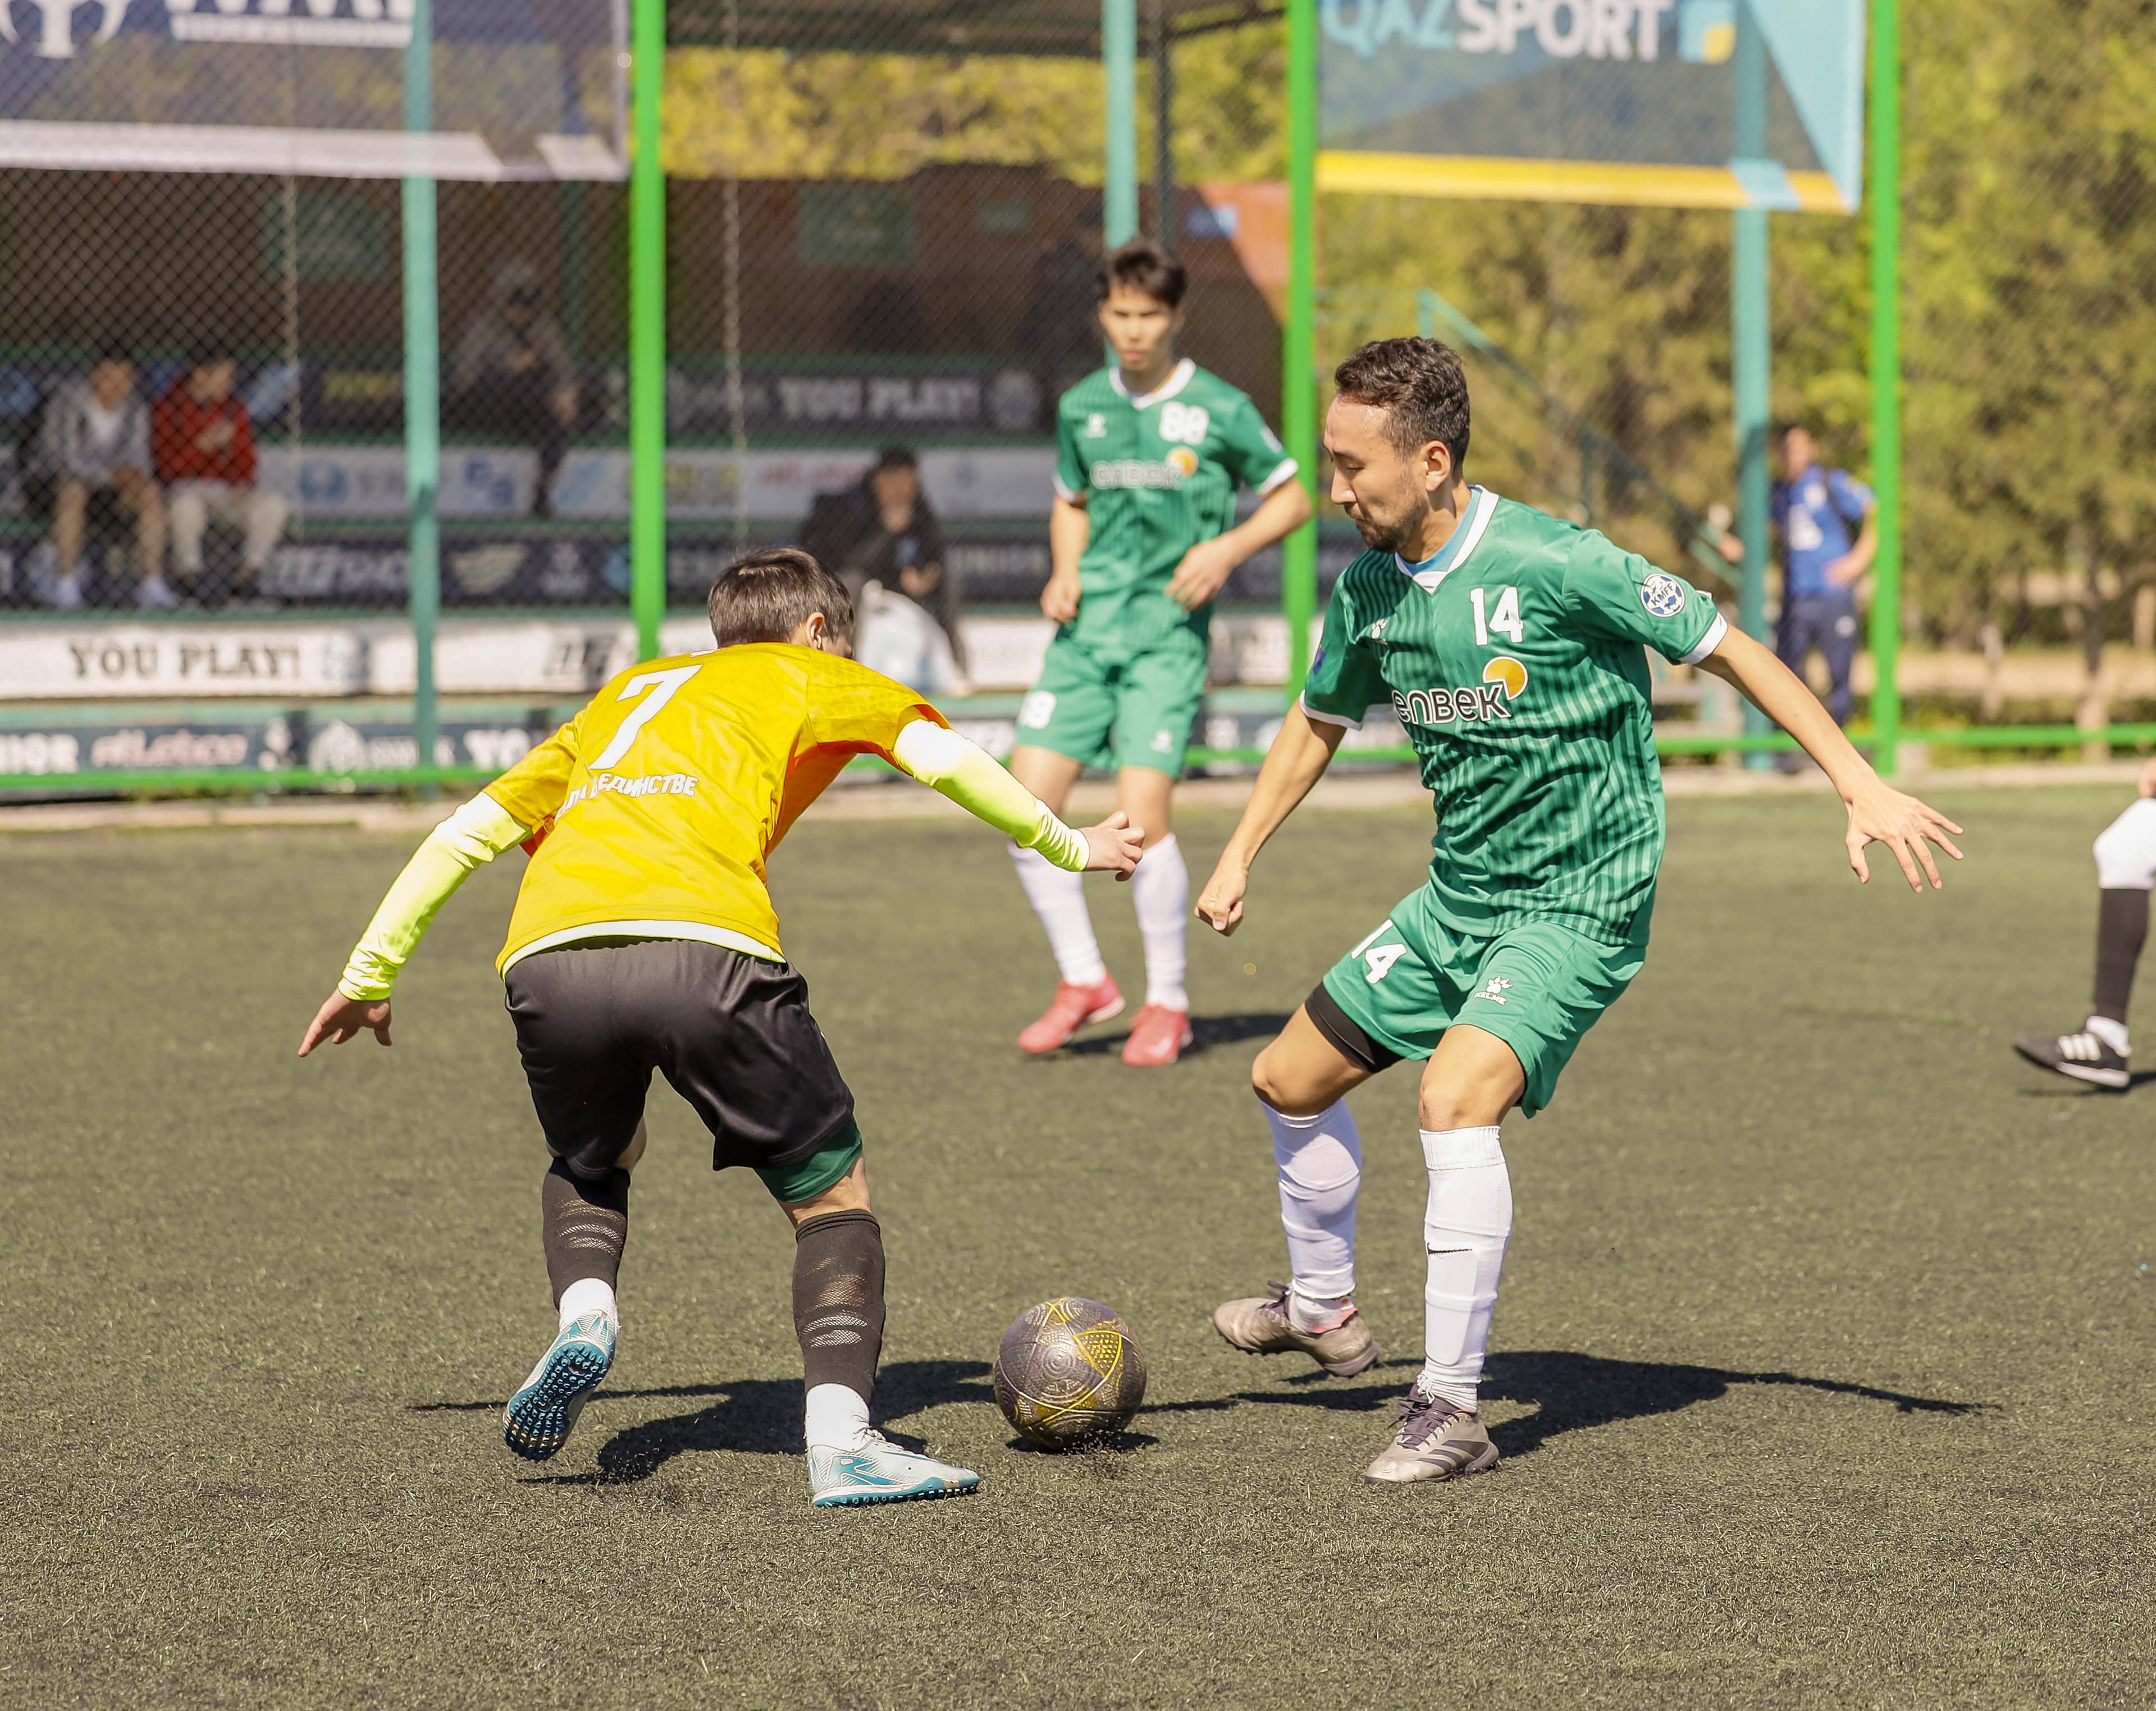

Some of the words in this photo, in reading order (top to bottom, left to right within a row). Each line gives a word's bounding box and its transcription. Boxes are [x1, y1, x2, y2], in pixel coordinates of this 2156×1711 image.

[1319, 0, 1670, 61] QAZSPORT
[1159, 401, 1209, 446] 88
[1470, 587, 1523, 646] 14
[1651, 582, 1673, 606] KMFF
[70, 643, 158, 680] YOU
[588, 664, 703, 770] 7
[597, 772, 698, 798] ЕДИНСТВЕ
[1351, 919, 1408, 985] 14
